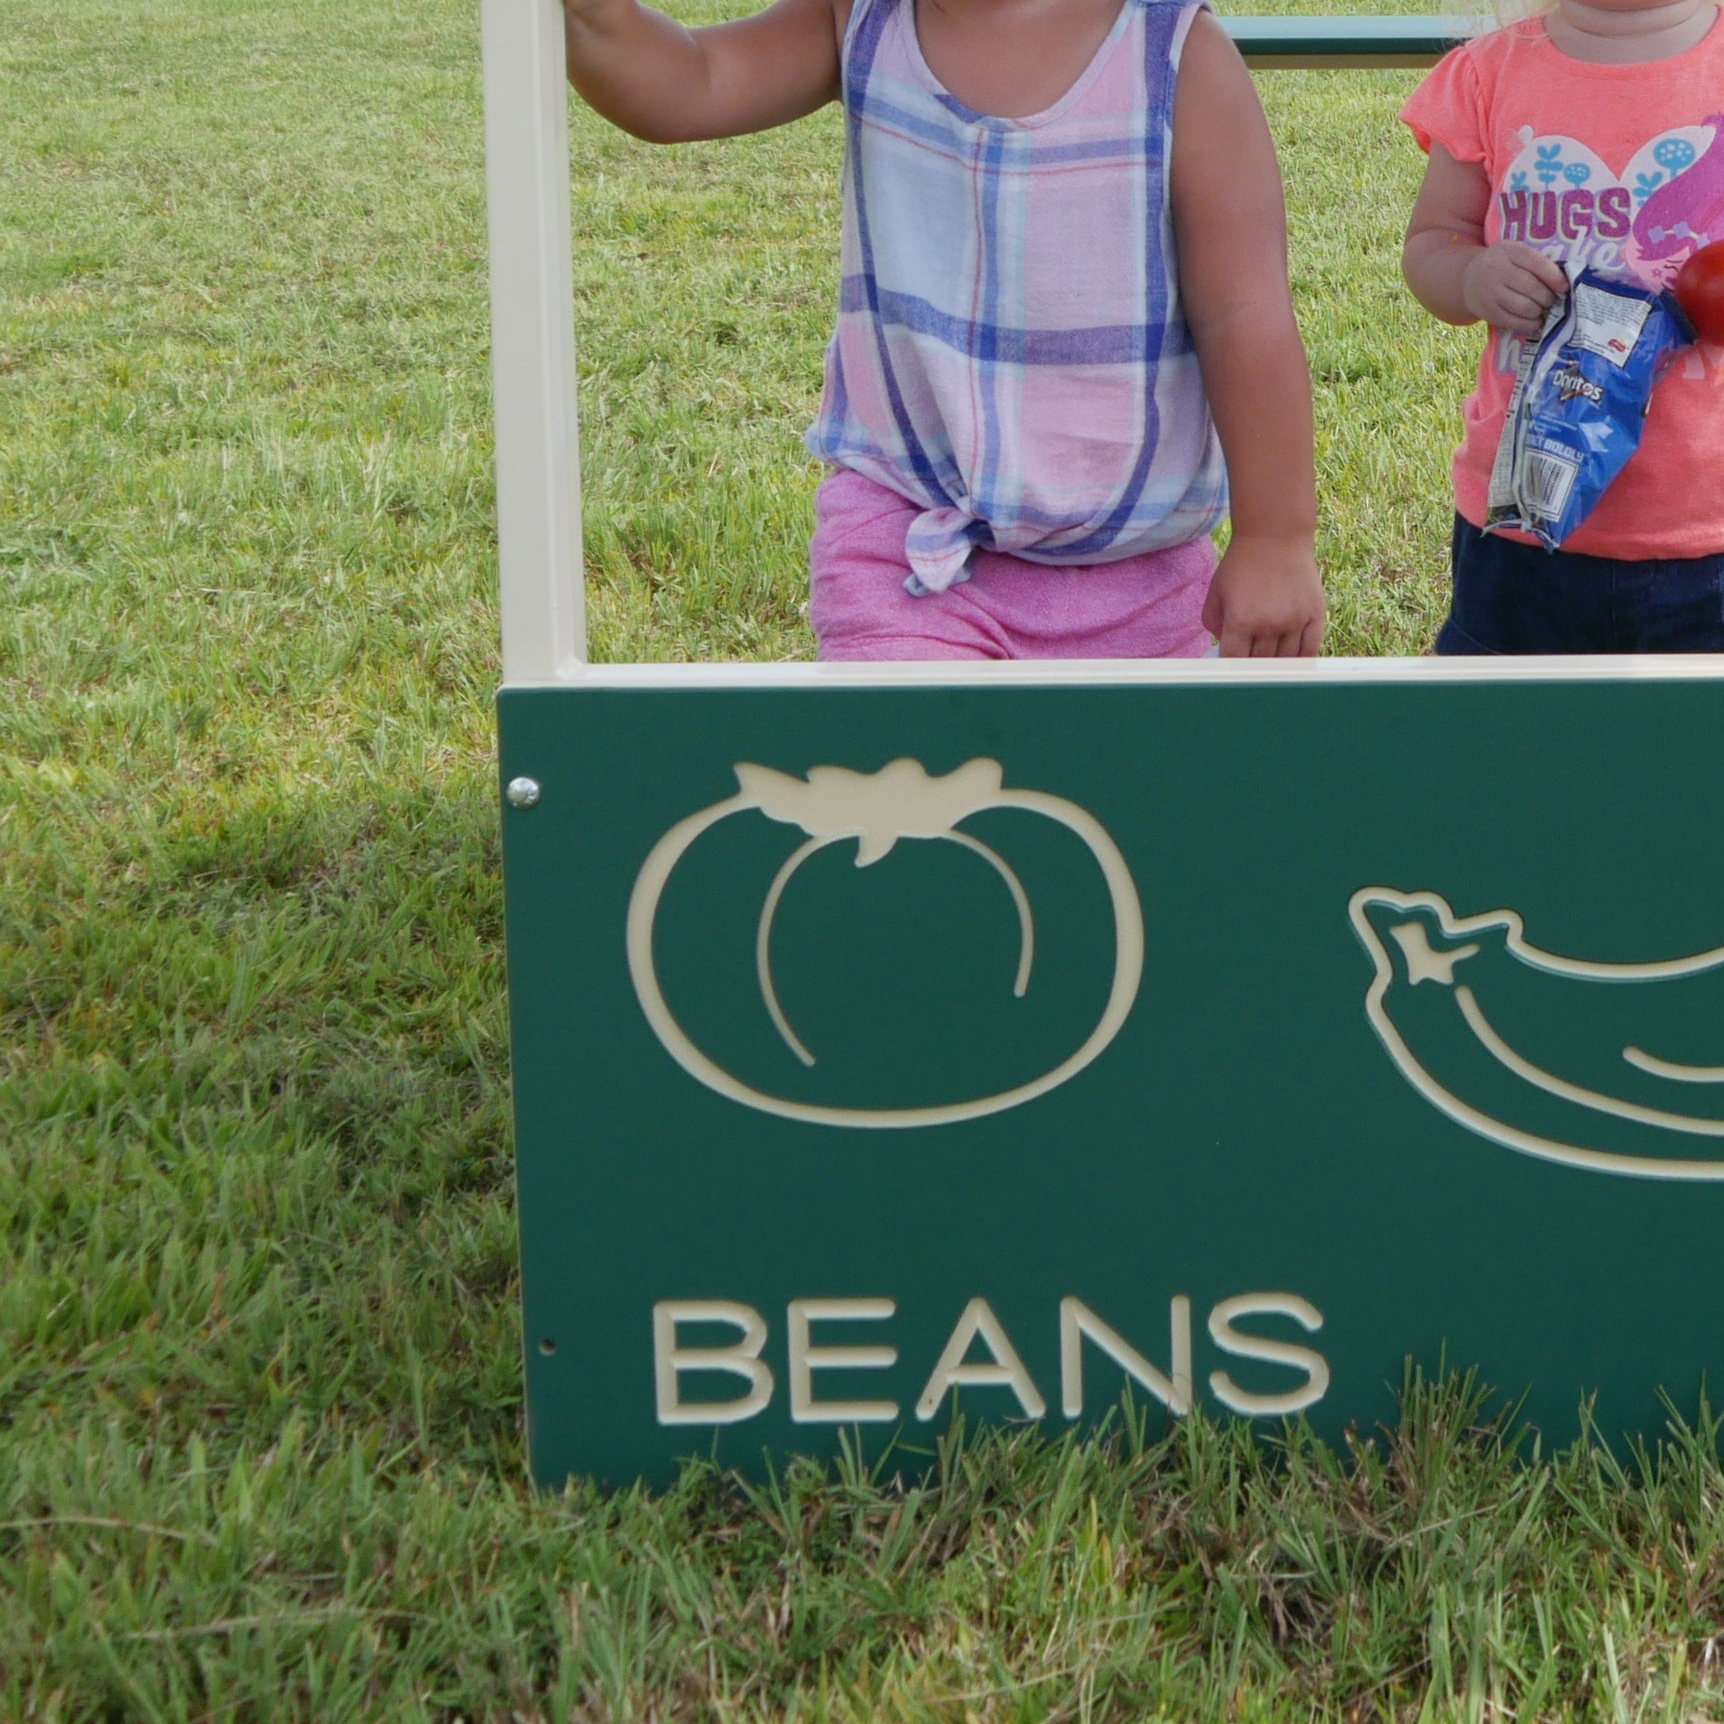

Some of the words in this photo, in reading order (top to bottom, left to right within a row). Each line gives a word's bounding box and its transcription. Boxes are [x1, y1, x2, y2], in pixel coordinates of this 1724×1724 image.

[1499, 187, 1631, 243] HUGS
[1552, 369, 1604, 404] Doritos
[653, 1294, 1331, 1425] BEANS
